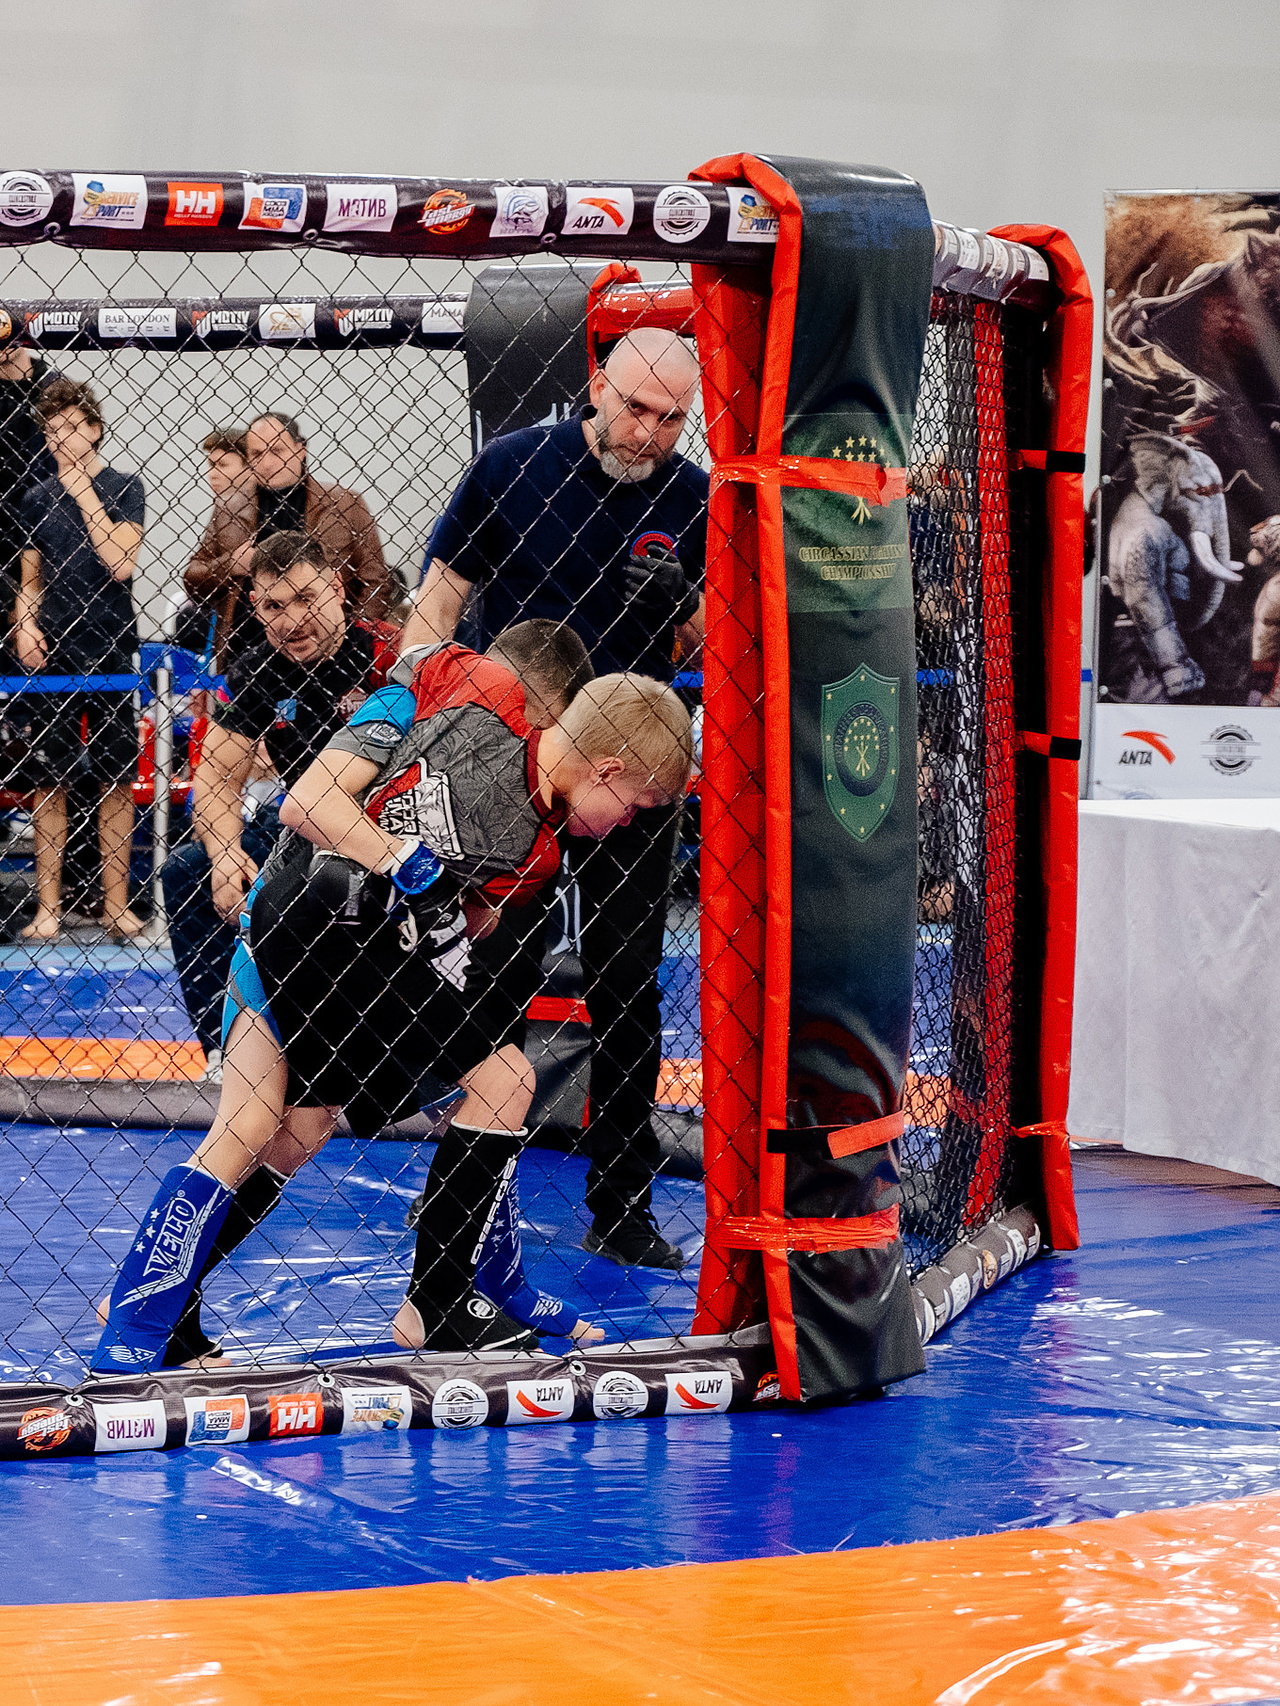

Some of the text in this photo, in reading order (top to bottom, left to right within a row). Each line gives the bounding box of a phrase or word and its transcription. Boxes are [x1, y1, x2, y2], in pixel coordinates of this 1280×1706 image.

[175, 190, 216, 214] HH
[572, 215, 605, 229] ANTA
[44, 311, 82, 325] MOTIV
[104, 314, 171, 323] BAR LONDON
[211, 310, 250, 324] MOTIV
[355, 308, 394, 322] MOTIV
[1119, 751, 1153, 766] ANTA
[142, 1197, 197, 1277] VELO
[694, 1379, 723, 1394] ANTA
[536, 1387, 563, 1402] ANTA
[277, 1408, 316, 1431] HH
